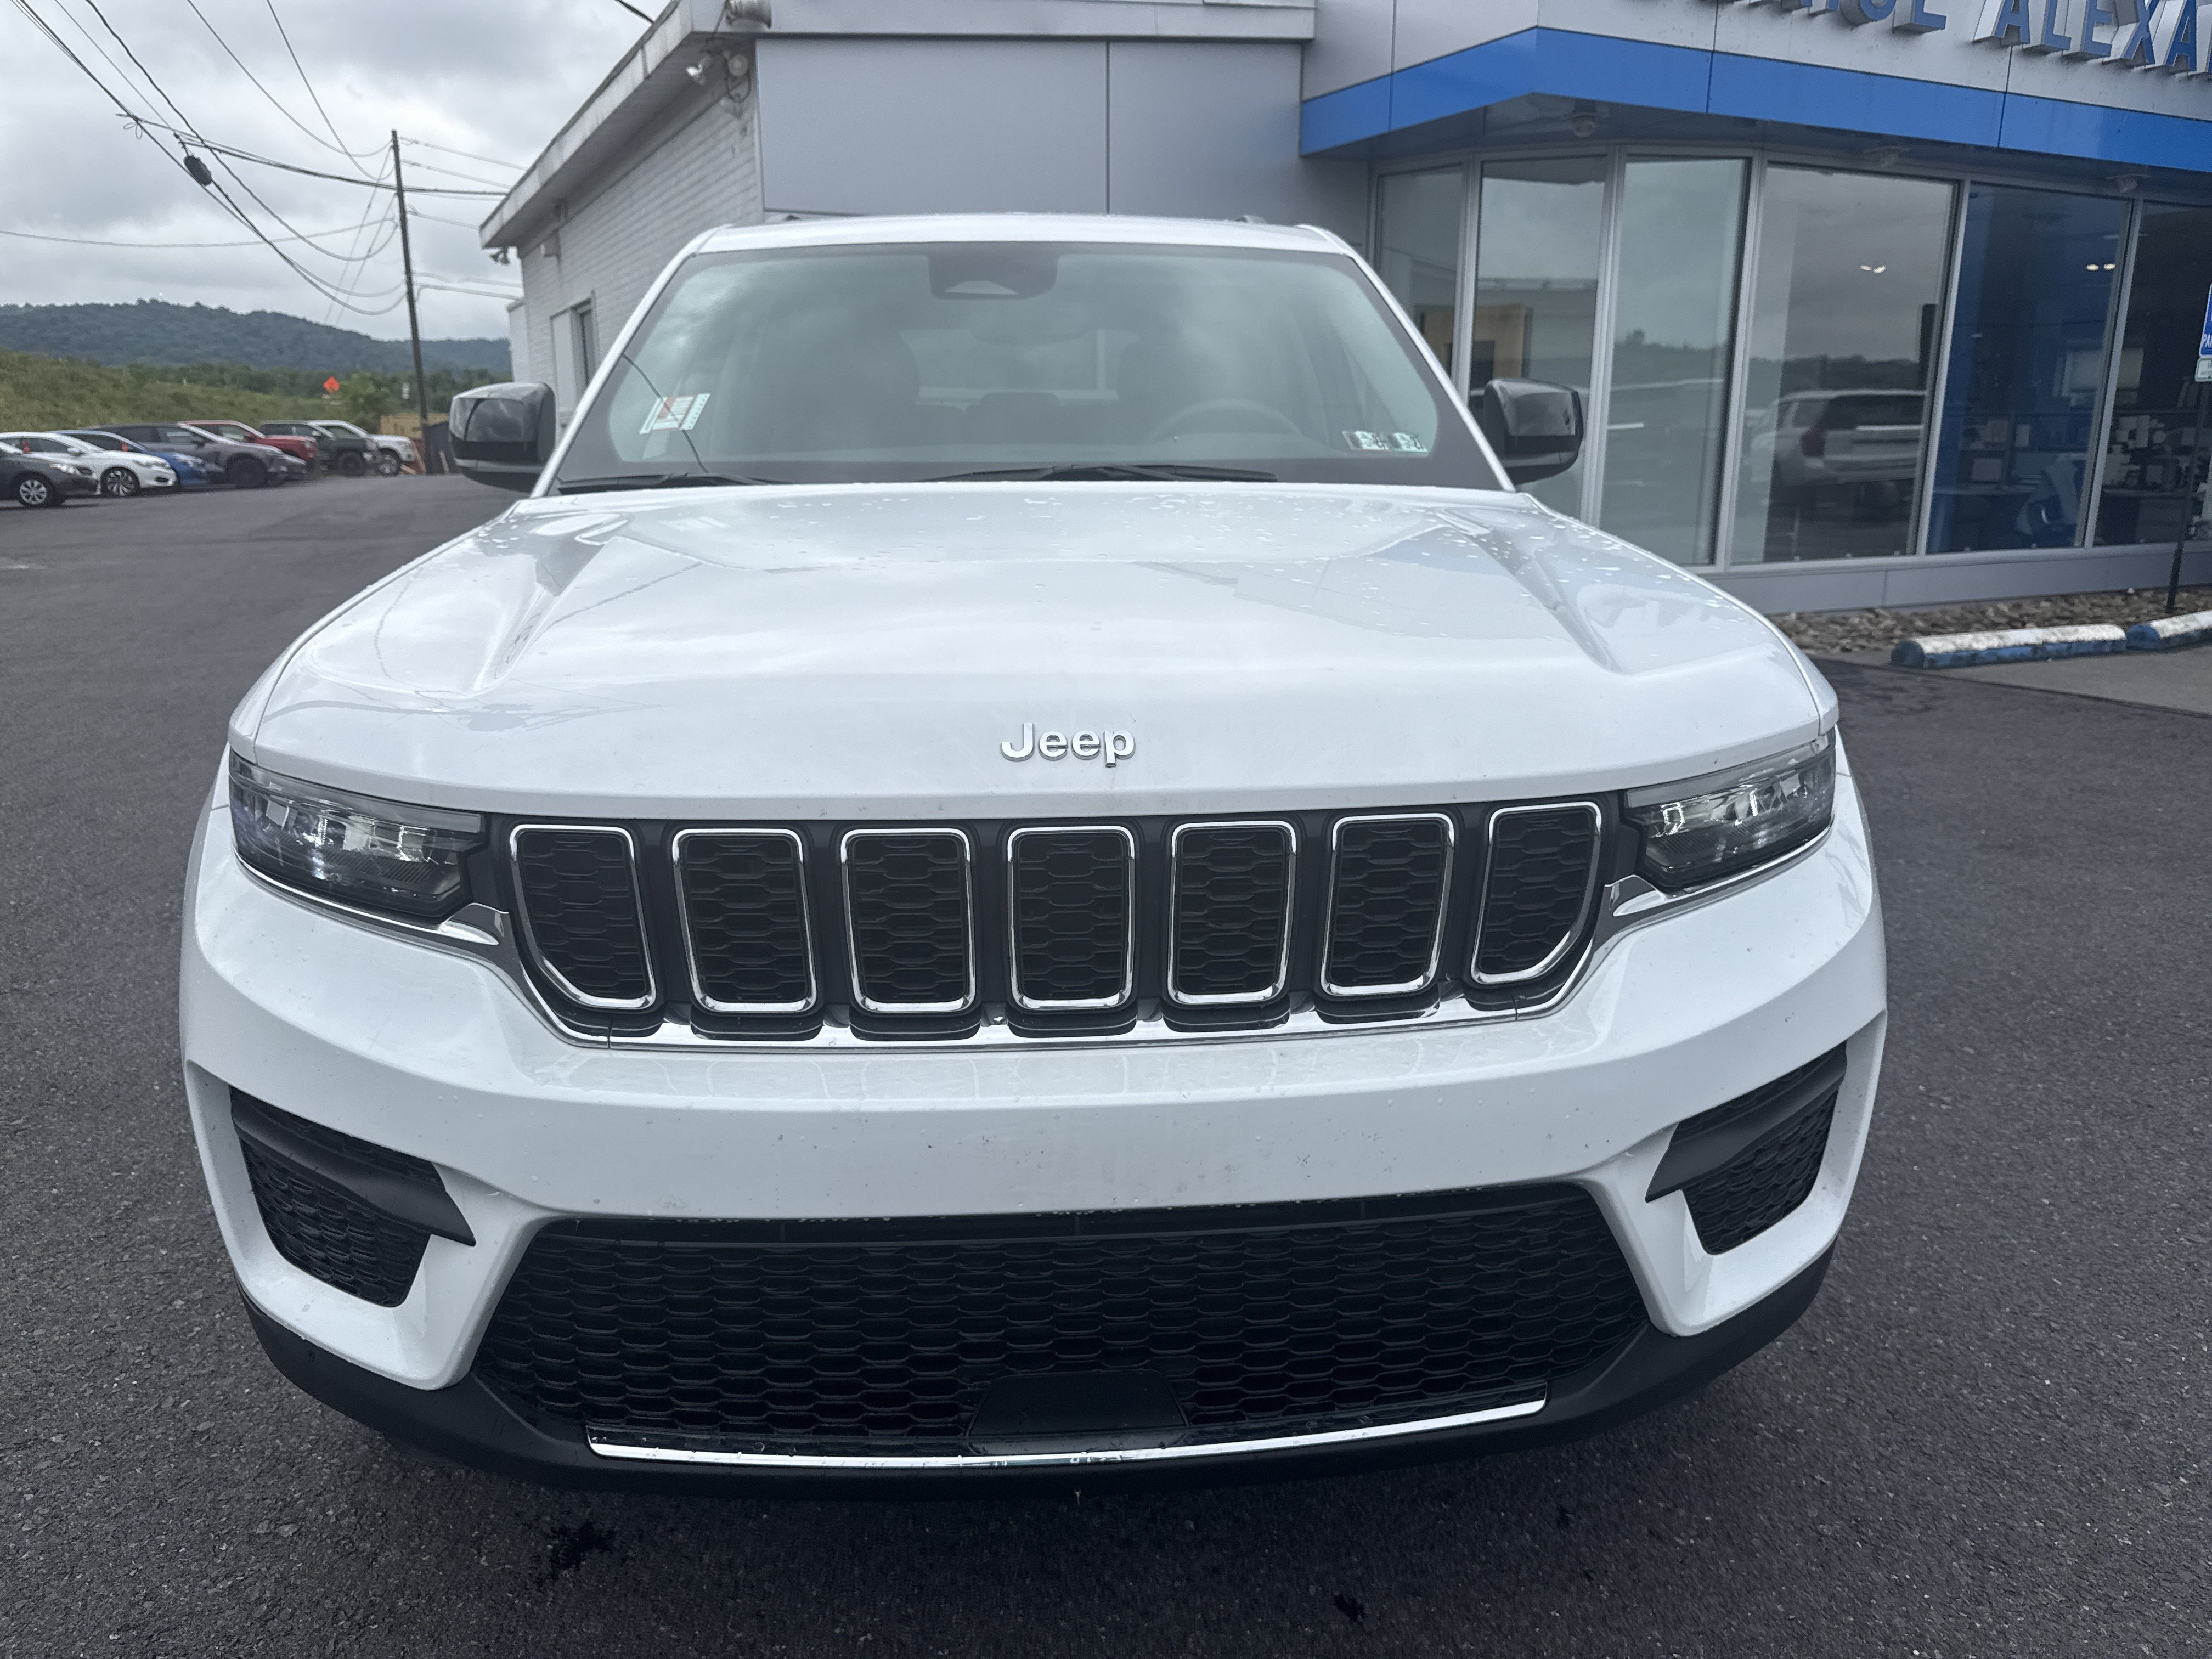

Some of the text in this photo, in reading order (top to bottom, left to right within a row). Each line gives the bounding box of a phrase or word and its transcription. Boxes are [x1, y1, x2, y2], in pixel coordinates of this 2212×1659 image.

[1990, 0, 2212, 74] ALEXA
[2202, 333, 2212, 347] PA
[1000, 723, 1136, 768] Jeep
